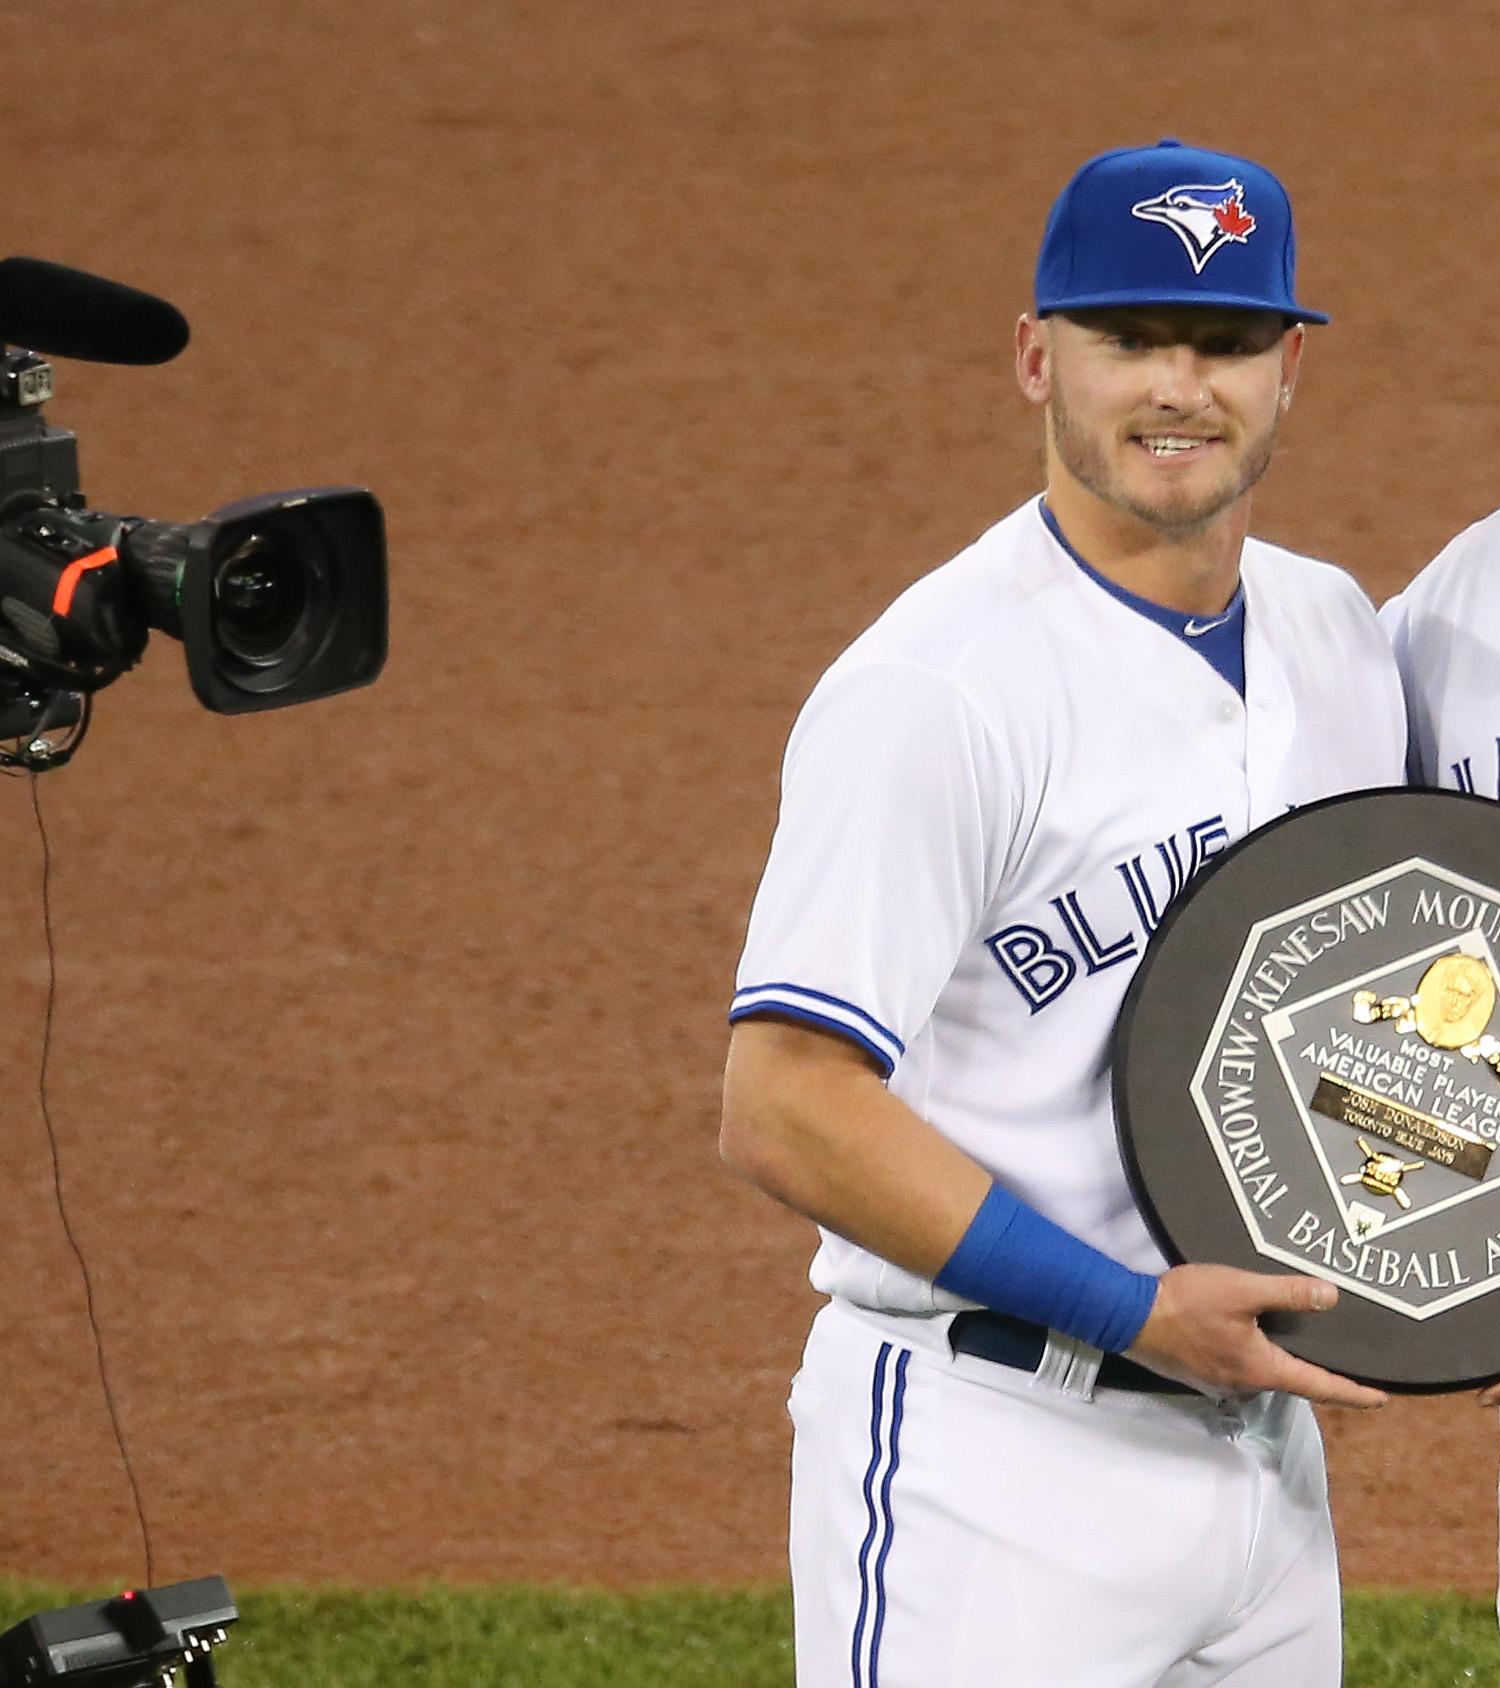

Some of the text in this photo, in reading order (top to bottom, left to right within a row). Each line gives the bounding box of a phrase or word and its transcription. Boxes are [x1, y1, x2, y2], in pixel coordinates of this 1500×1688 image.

[1242, 890, 1391, 1012] KENESAW
[1300, 1043, 1424, 1106] AMERICAN
[1330, 1027, 1428, 1084] VALUABLE
[1400, 1039, 1454, 1072] MOST
[1341, 1090, 1467, 1151] JOSH DONALDSON
[1343, 1109, 1456, 1165] TORONTO BLUE JAYS
[1217, 1018, 1289, 1219] MEMORIAL
[1287, 1210, 1471, 1289] BASEBALL
